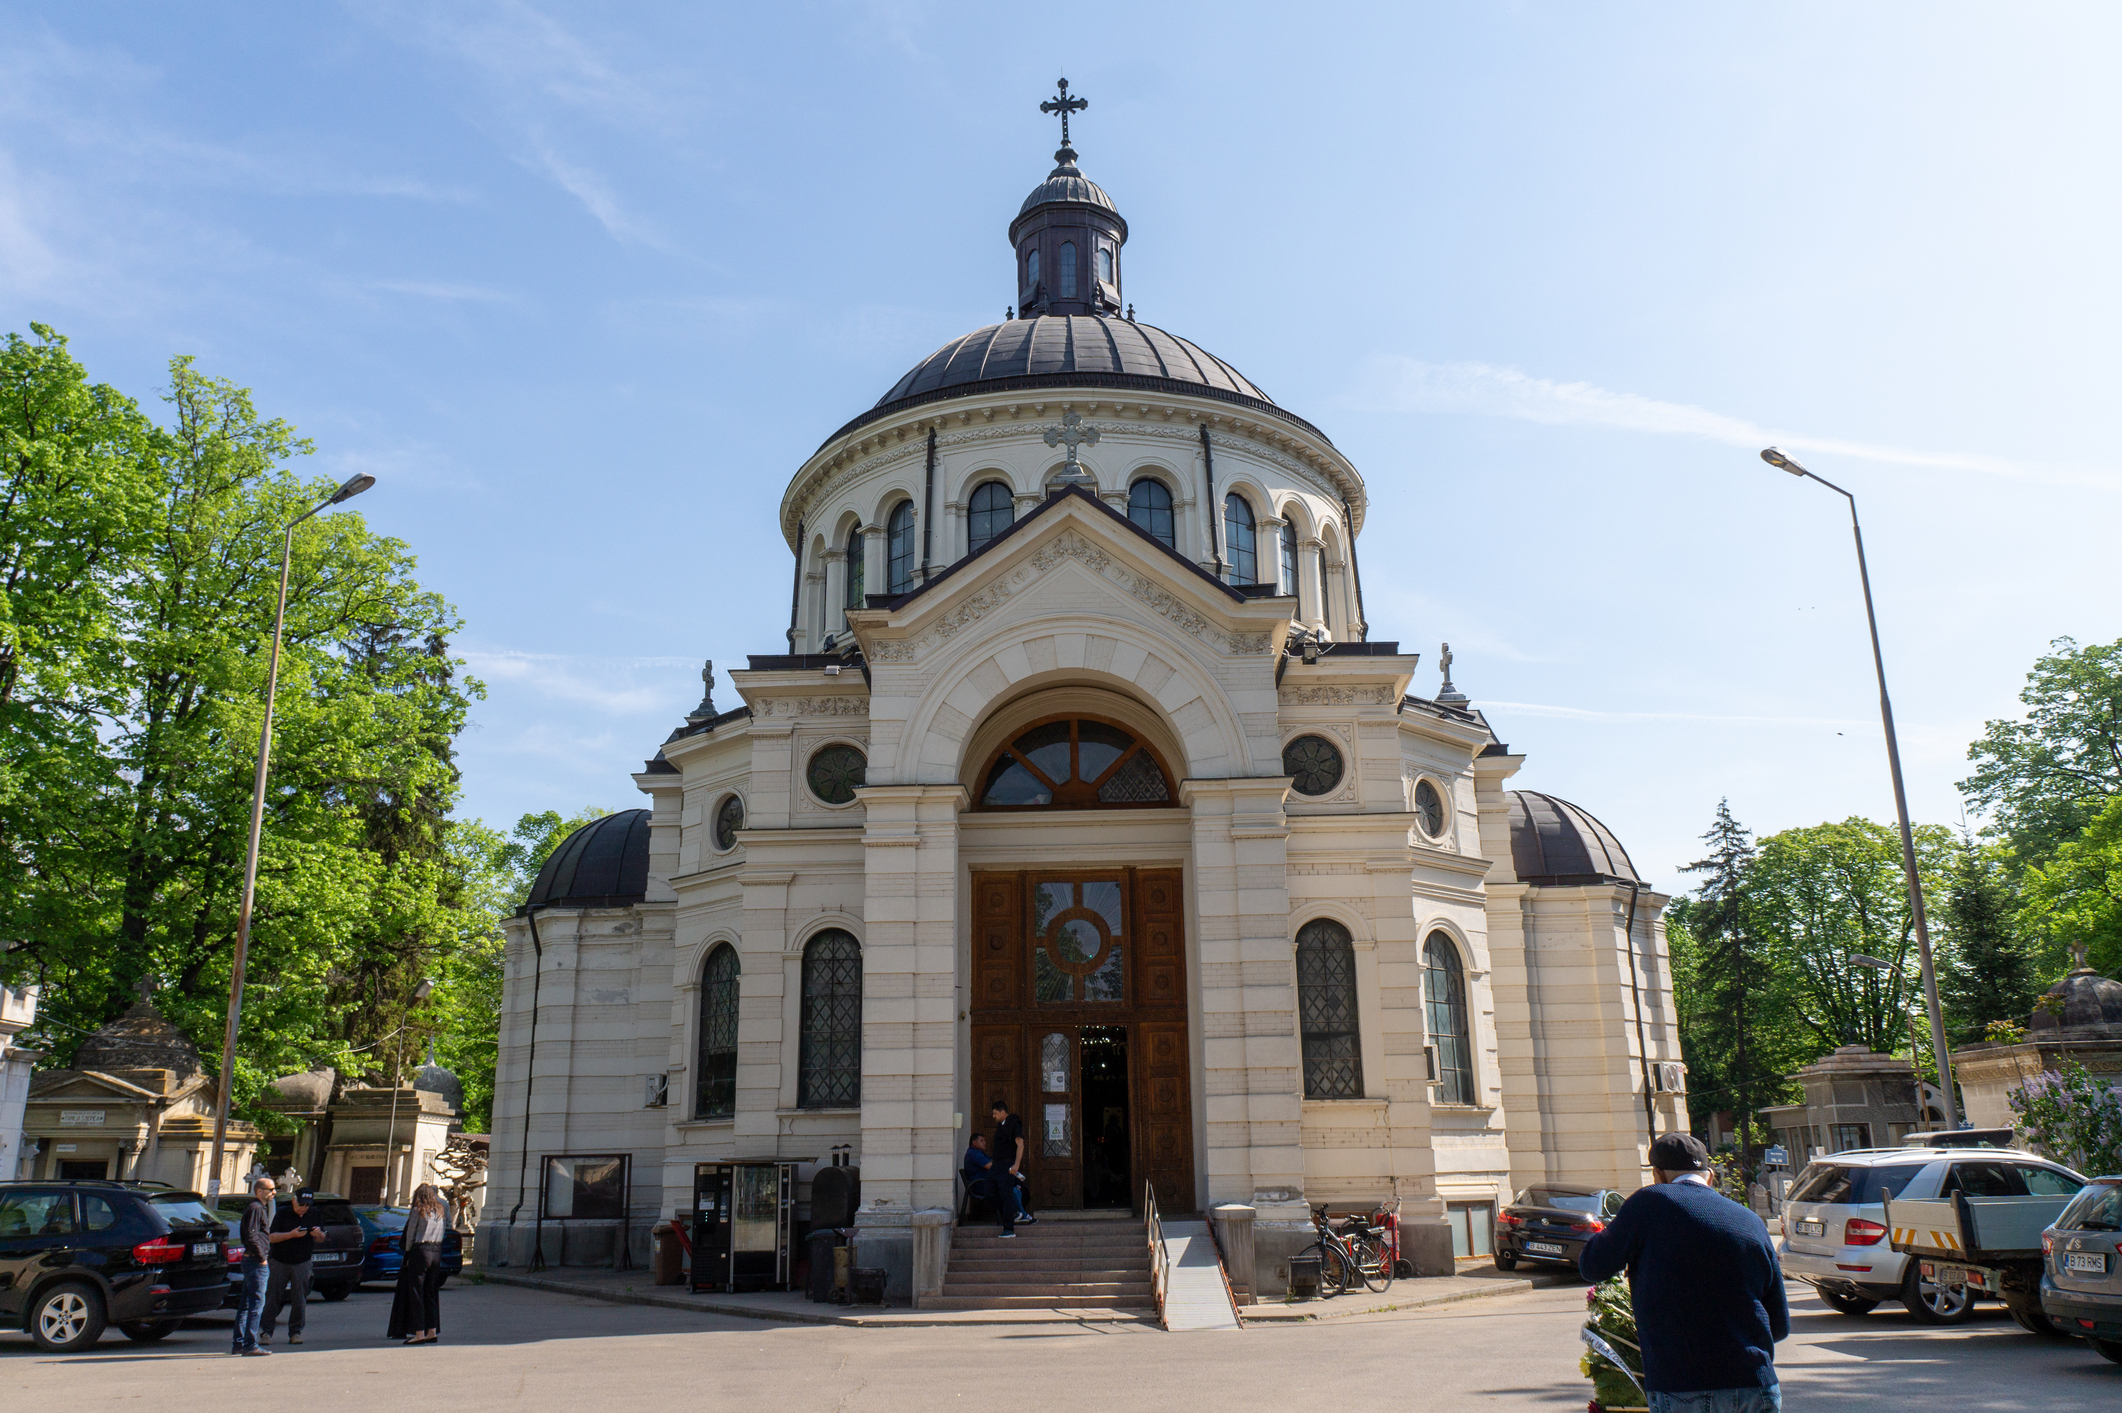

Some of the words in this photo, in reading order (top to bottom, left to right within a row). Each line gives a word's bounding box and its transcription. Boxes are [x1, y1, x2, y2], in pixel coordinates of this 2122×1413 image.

[2070, 1255, 2075, 1266] B
[2077, 1256, 2085, 1267] 73
[2087, 1256, 2102, 1268] RMS
